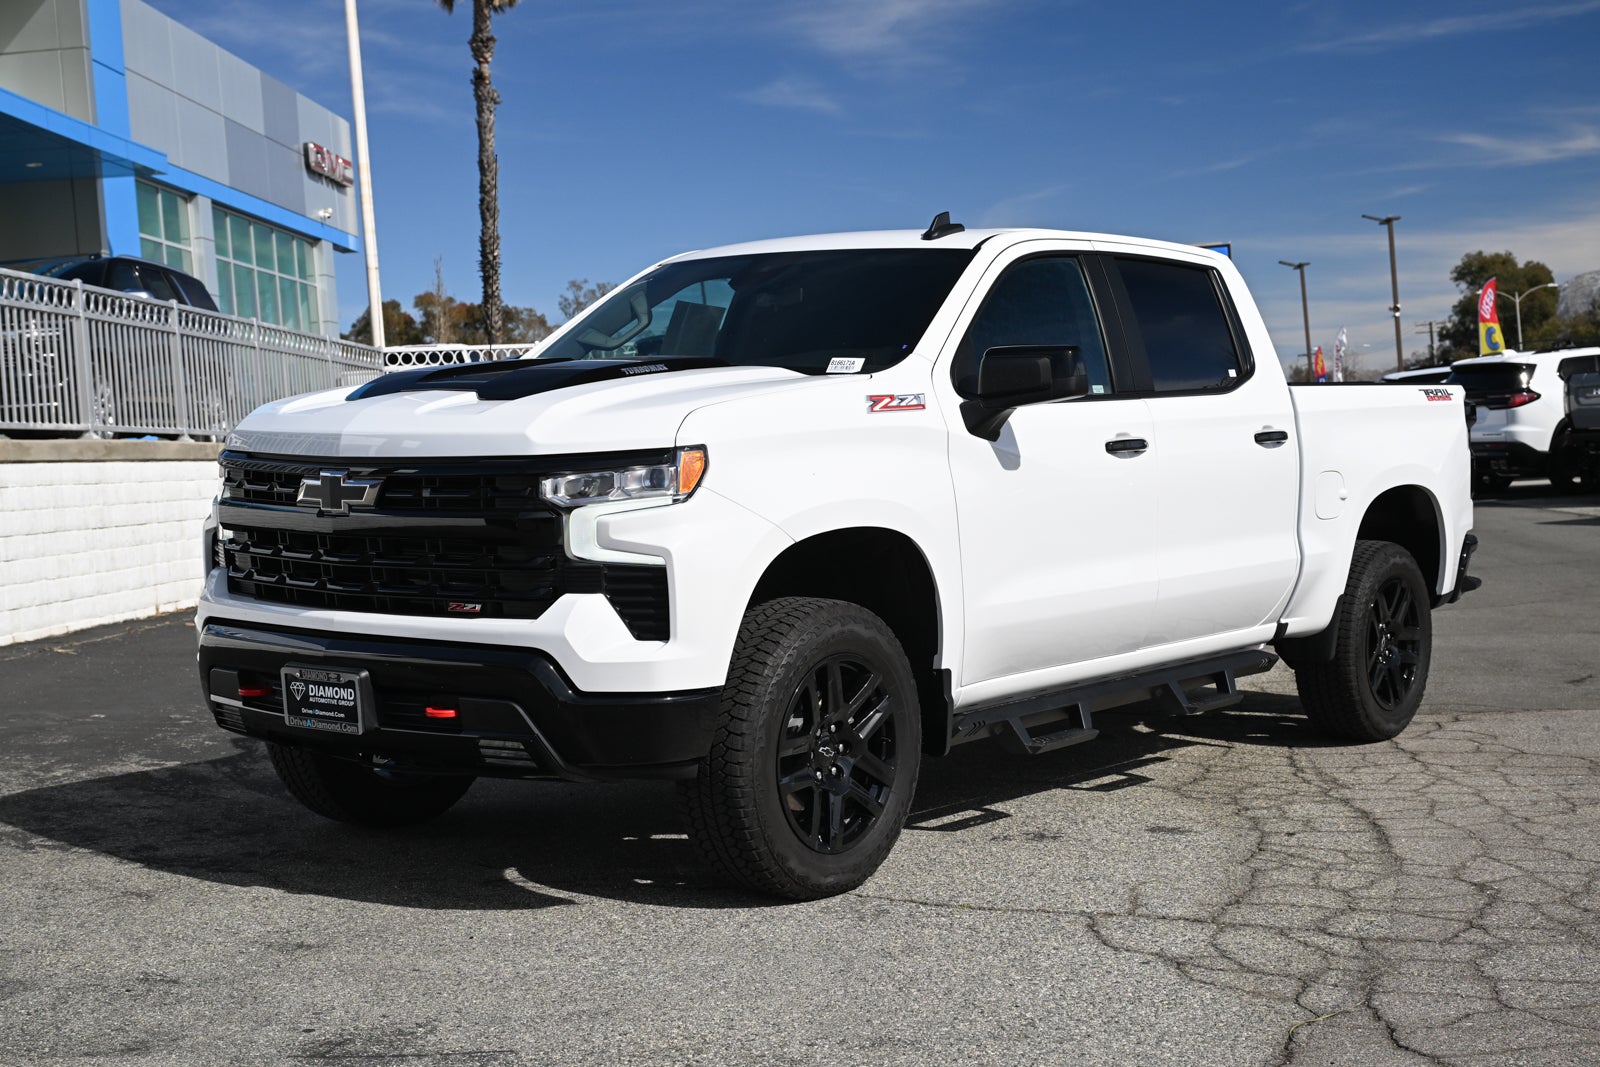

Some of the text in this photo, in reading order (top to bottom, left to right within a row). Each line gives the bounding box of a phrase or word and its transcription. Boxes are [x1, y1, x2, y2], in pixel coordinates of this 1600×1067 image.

[308, 142, 353, 188] GMC
[1480, 288, 1495, 319] USED
[1418, 388, 1453, 396] TRAIL
[865, 393, 926, 414] Z71
[448, 602, 482, 613] Z71
[308, 684, 355, 701] DIAMOND
[309, 697, 338, 705] AUTOMOTIVE
[289, 716, 358, 733] DriveADiamond.Com
